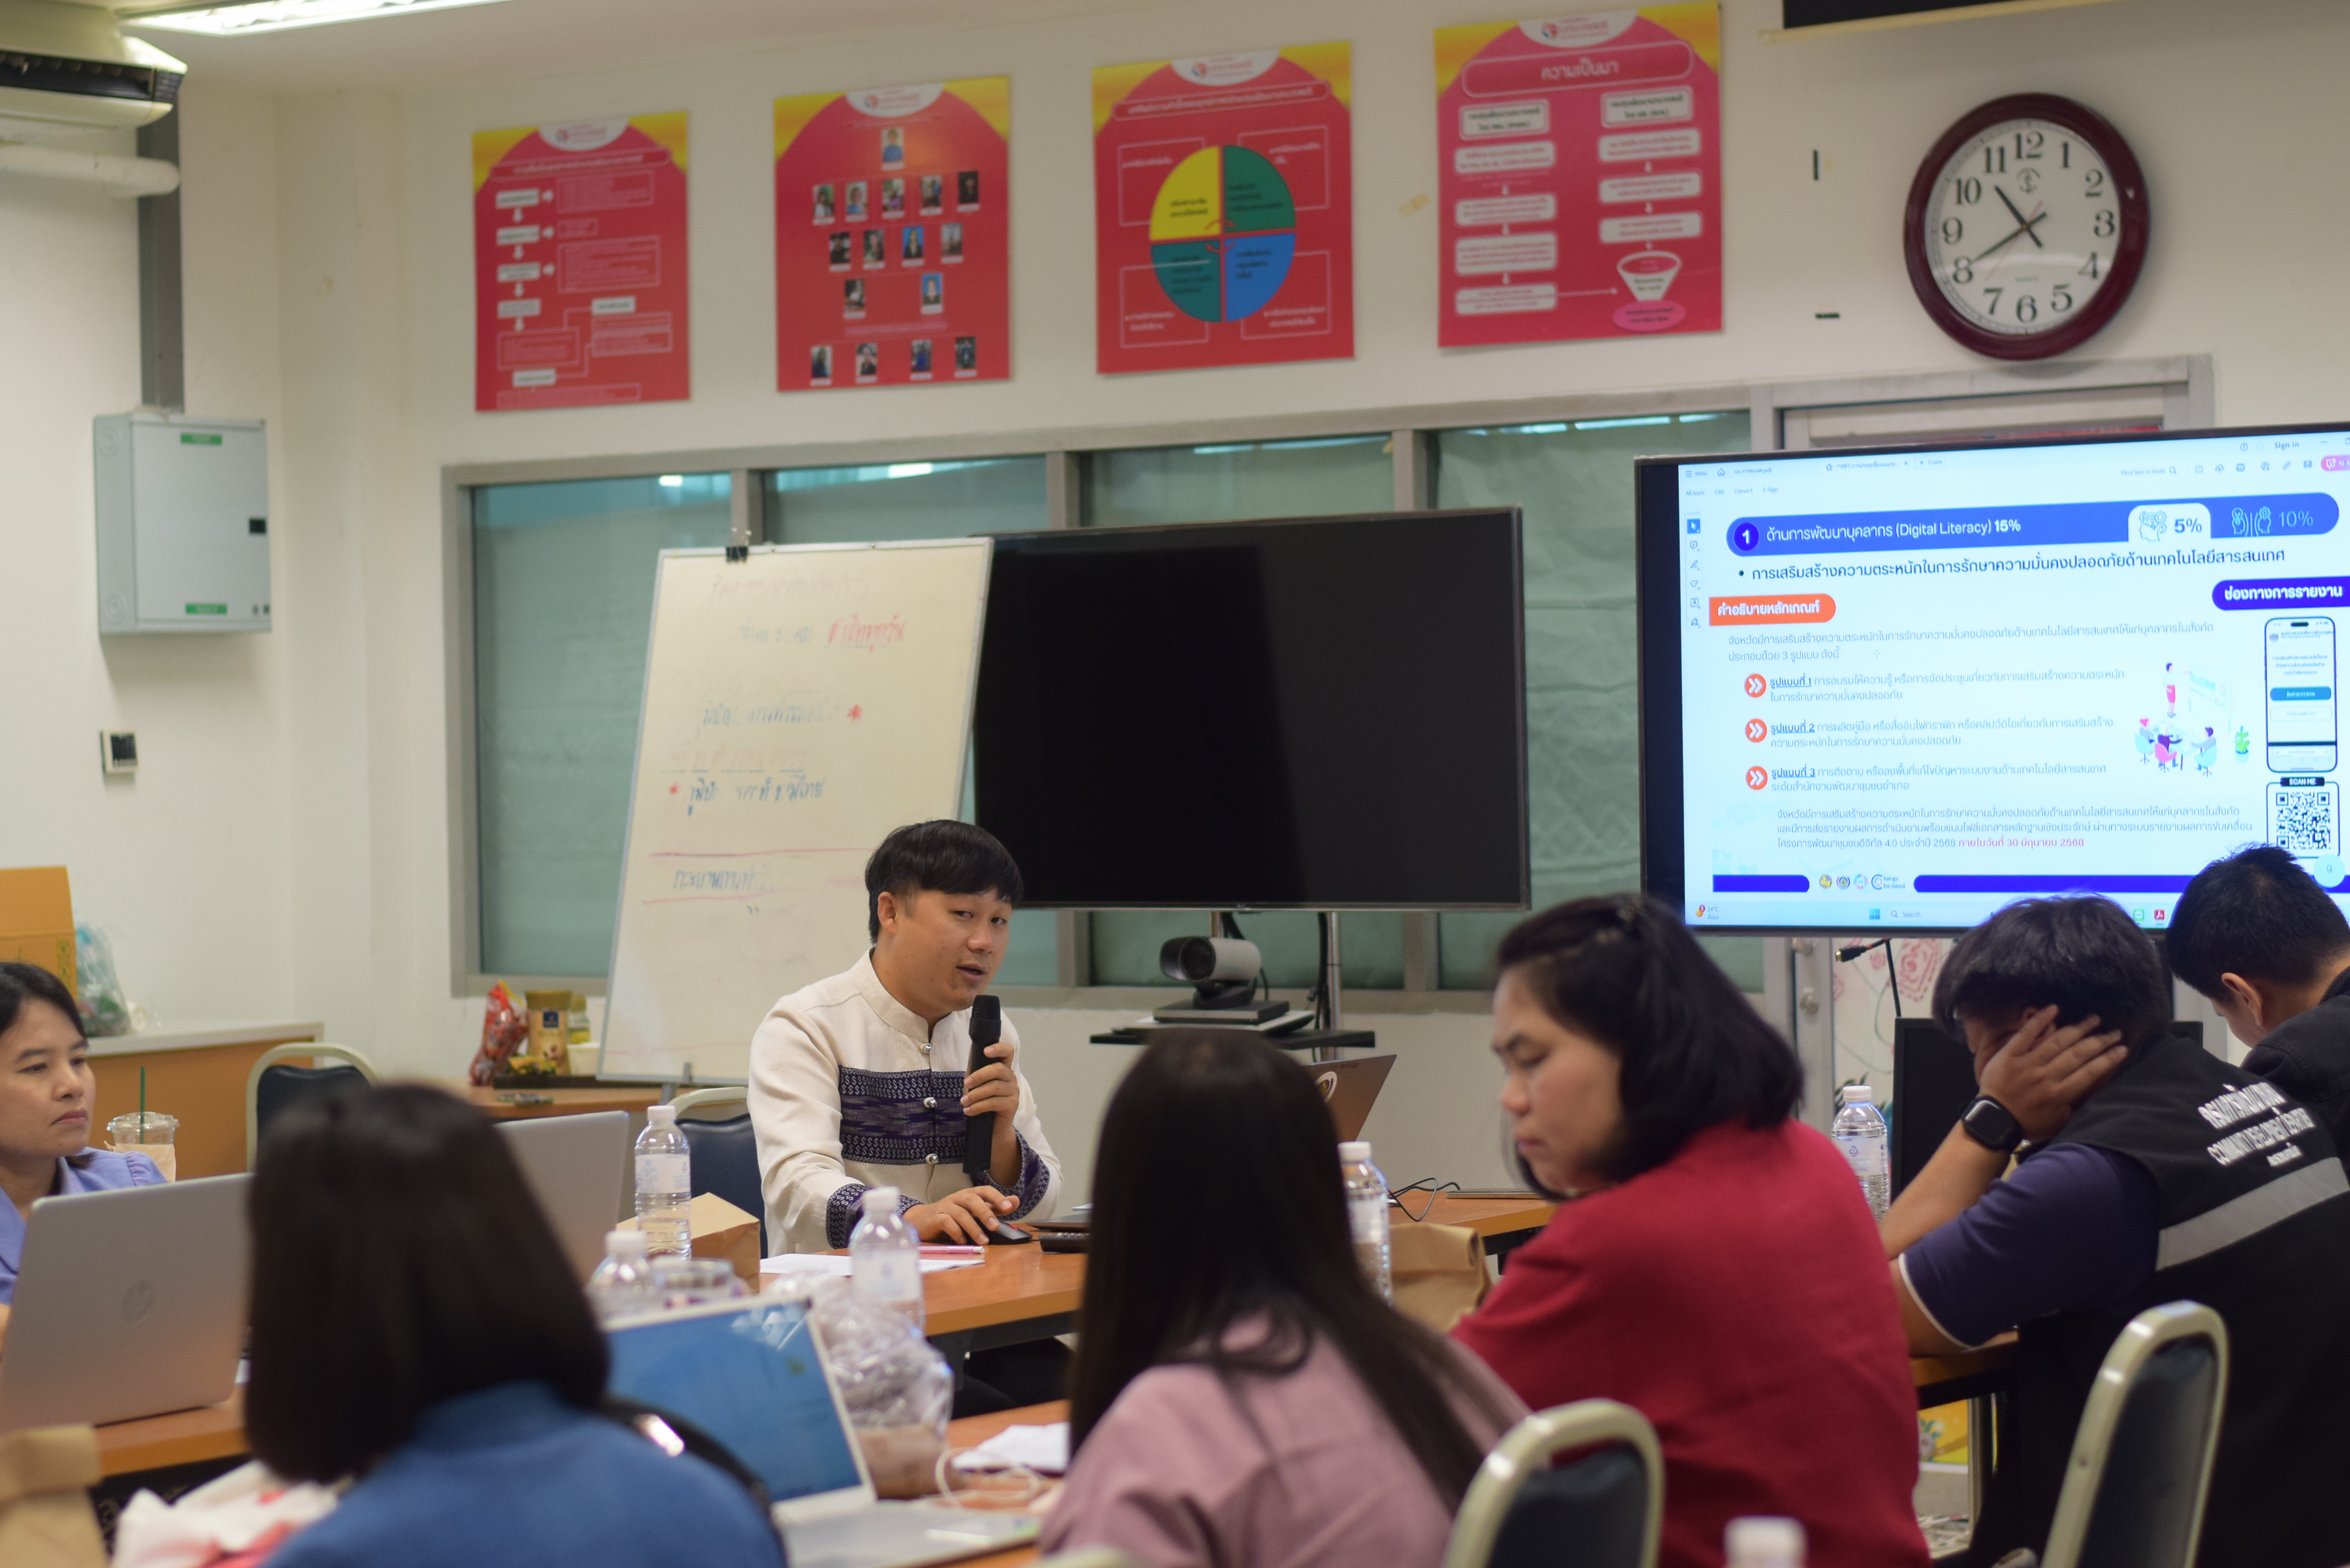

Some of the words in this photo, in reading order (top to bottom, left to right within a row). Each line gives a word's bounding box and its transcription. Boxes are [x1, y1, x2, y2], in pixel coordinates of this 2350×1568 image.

[2014, 131, 2044, 159] 12
[2061, 141, 2070, 168] 1
[1984, 145, 2007, 173] 11
[1955, 177, 1982, 205] 10
[2085, 168, 2103, 197] 2
[1942, 217, 1963, 244] 9
[2094, 210, 2115, 237] 3
[1952, 256, 1974, 284] 8
[2078, 251, 2100, 279] 4
[1984, 287, 2003, 315] 7
[2016, 295, 2037, 322] 6
[2051, 284, 2072, 312] 5
[2174, 519, 2202, 534] 5%
[2279, 511, 2313, 528] 10%
[1742, 530, 1749, 544] 1
[1767, 524, 1893, 544] ด้านการพัฒนาบุคลากร
[1896, 522, 1937, 538] (Digital
[1940, 519, 1991, 537] Literacy)
[1994, 520, 2021, 533] 15%
[1753, 549, 2285, 580] การเสริมสร้างความตระหนักในการรักษาความมั่นคงปลอดภัยด้านเทคโนโลยีสารสนเทศ
[2225, 585, 2343, 601] ช่องทางการรายงาน
[1718, 599, 1820, 616] คำอธิบายหลักเกณฑ์
[1729, 651, 1780, 661] ประกอบด้วย
[1790, 650, 1818, 662] รูปแบบ
[1821, 646, 1839, 659] ดังนี้
[1770, 673, 1805, 688] รูปแบบที่
[1808, 677, 1812, 685] 1
[1814, 673, 1892, 686] การอบรมให้ความรู้
[1894, 670, 2124, 684] หรือการจัดประชุมเกี่ยวกับการเสริมสร้างความตระหนัก
[1770, 688, 1902, 701] ในการรักษาความมั่นคงปลอดภัย
[1770, 719, 1806, 735] รูปแบบที่
[1817, 720, 1870, 733] การผลิตคู่มือ
[1873, 718, 1955, 731] หรือสื่ออินโฟกราฟิก
[1771, 733, 1961, 747] ความตระหนักในการรักษาความมั่นคงปลอดภัย
[1771, 764, 1806, 779] รูปแบบที่
[1818, 766, 1863, 777] การติดตาม
[1772, 779, 1909, 792] ระดับสำนักงานพัฒนาชุมชนอำเภอ
[2093, 818, 2252, 831] ผ่านทางระบบรายงานผลการขับเคลื่อน
[1778, 838, 1882, 849] โครงการพัฒนาชุมชนดิจิทัล
[1885, 839, 1897, 847] 4.0
[1900, 837, 1930, 847] ประจำปี
[1933, 839, 1955, 847] 2568
[1959, 835, 2004, 847] ภายในวันที่
[2021, 838, 2057, 849] มิถุนายน
